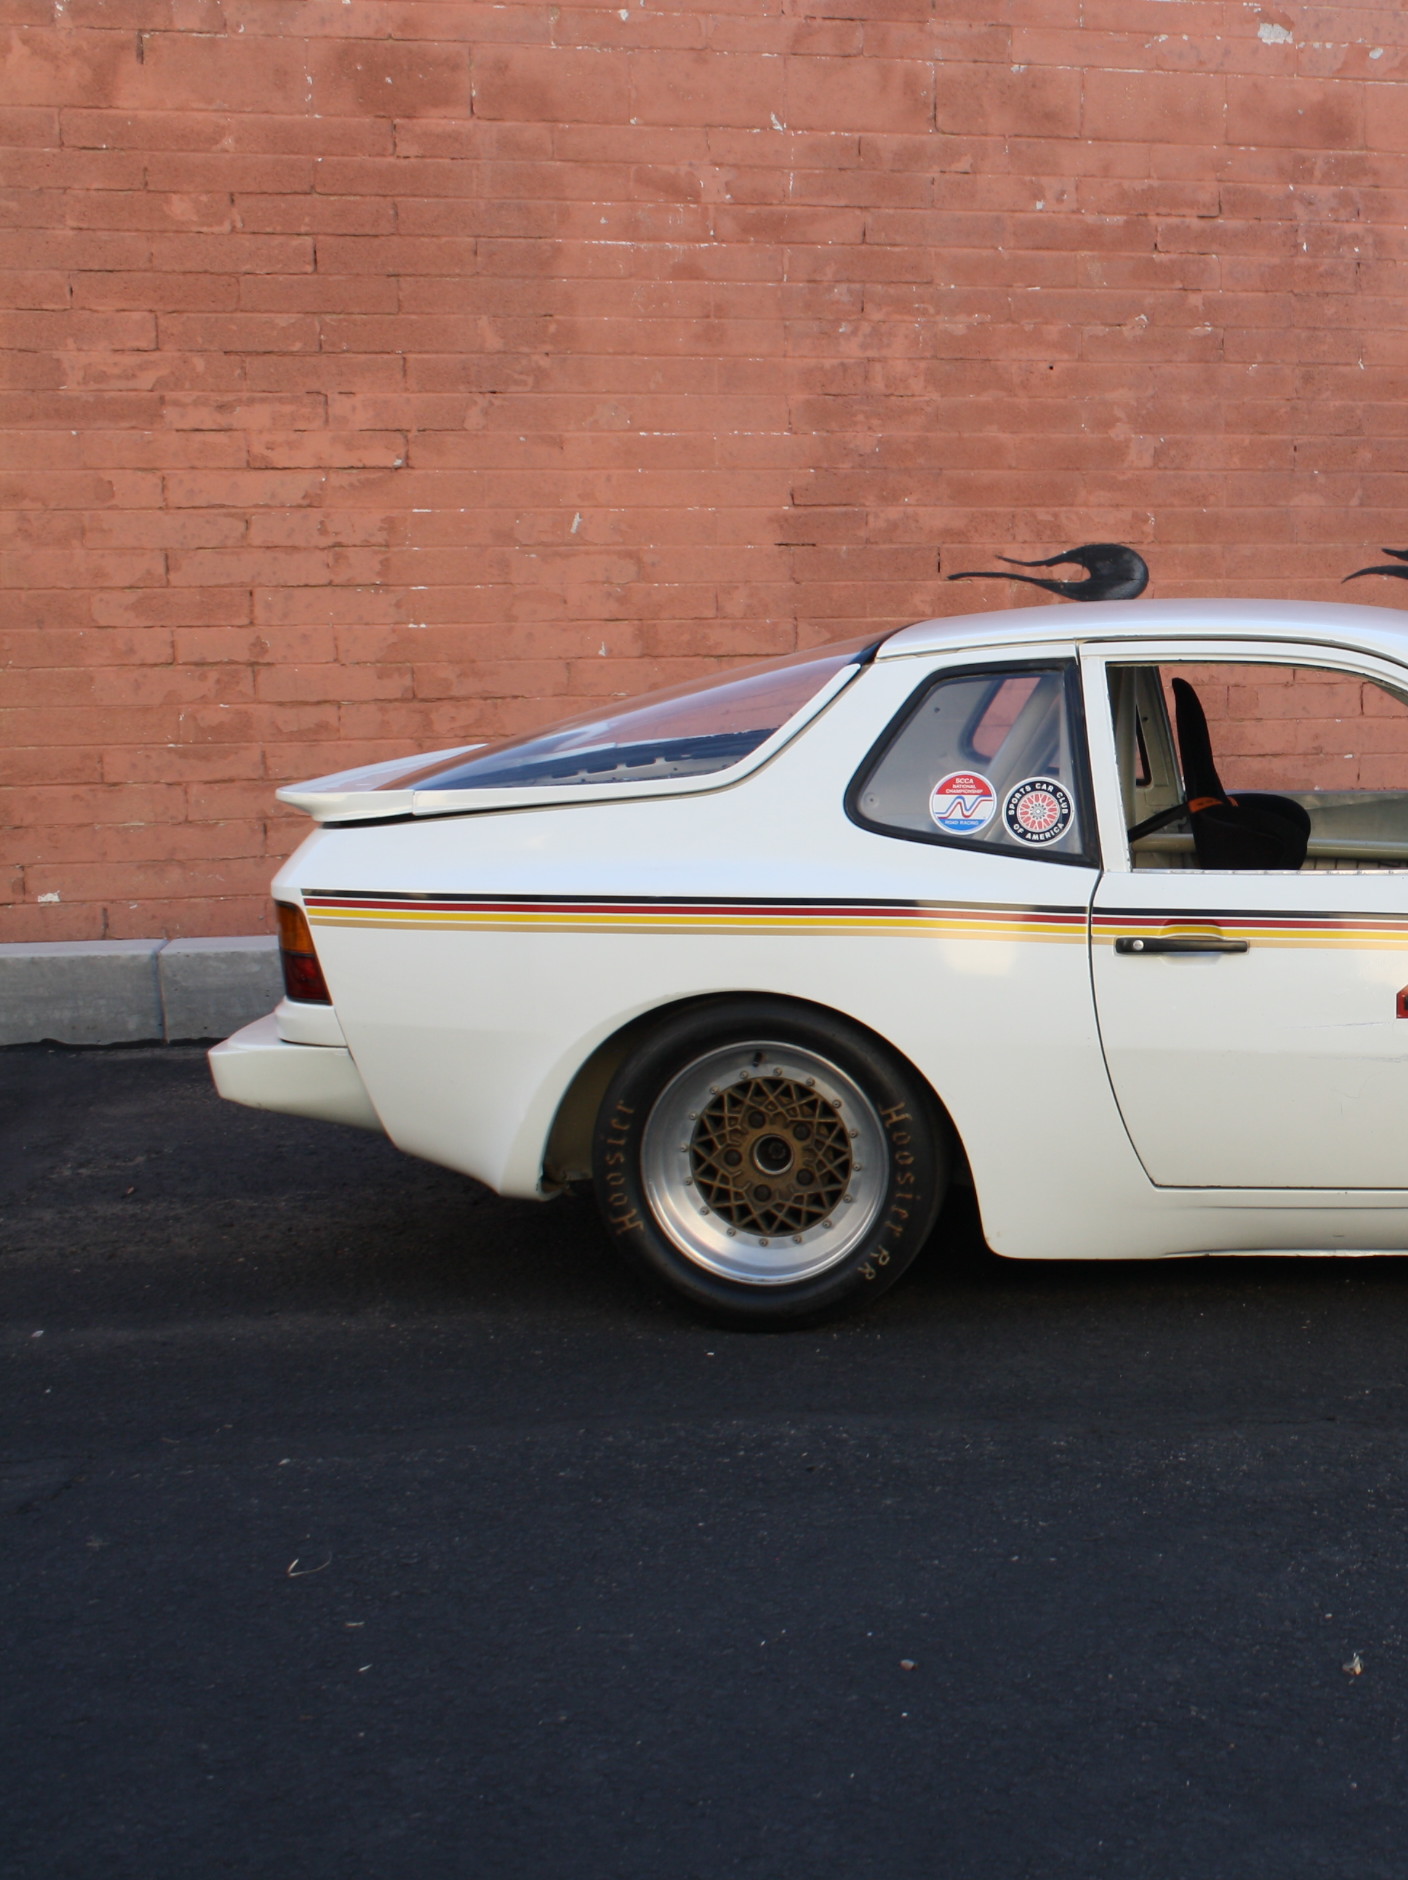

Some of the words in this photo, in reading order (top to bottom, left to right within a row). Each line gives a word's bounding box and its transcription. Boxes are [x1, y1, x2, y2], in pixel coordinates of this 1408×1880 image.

[1008, 785, 1031, 815] SPORTS
[1035, 783, 1054, 792] CAR
[1056, 792, 1068, 814] CLUB
[1013, 824, 1025, 834] OF
[1025, 823, 1065, 840] AMERICA
[600, 1099, 646, 1236] Hoosier
[877, 1100, 921, 1238] Hoosier
